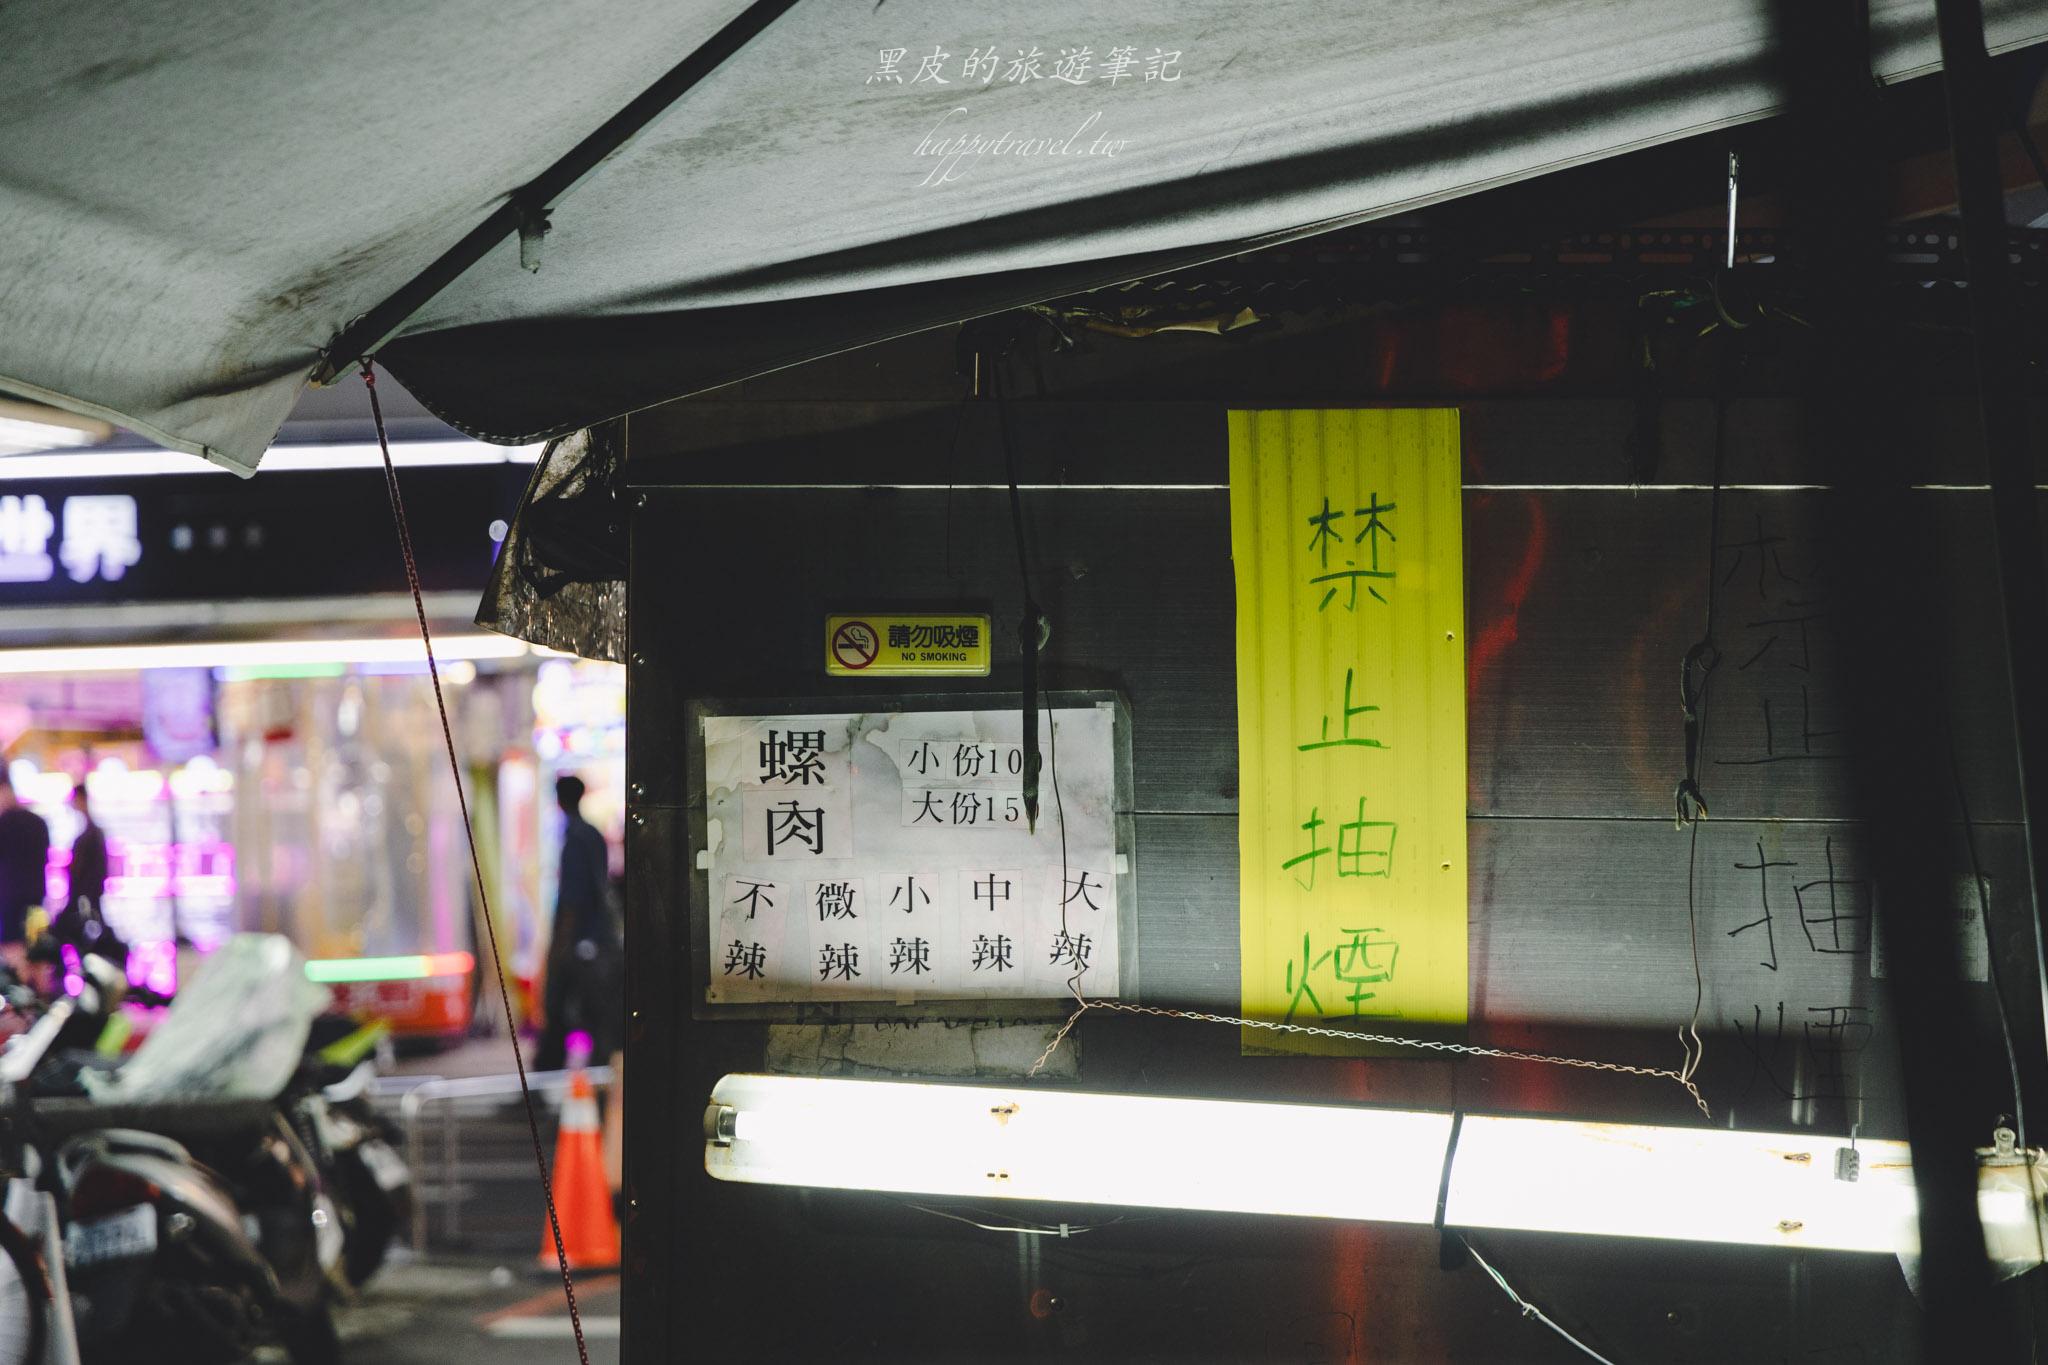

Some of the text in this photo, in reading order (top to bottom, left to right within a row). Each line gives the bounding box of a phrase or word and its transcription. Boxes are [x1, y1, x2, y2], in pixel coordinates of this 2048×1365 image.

[888, 624, 979, 649] 請勿吸煙
[901, 652, 967, 662] NO SMOKING
[758, 728, 826, 857] 螺肉
[1282, 492, 1402, 1037] 禁止抽煙
[723, 880, 776, 981] 不辣
[814, 881, 862, 982] 微辣
[888, 875, 931, 976] 小辣
[972, 872, 1014, 973] 中辣
[1049, 871, 1103, 971] 大辣
